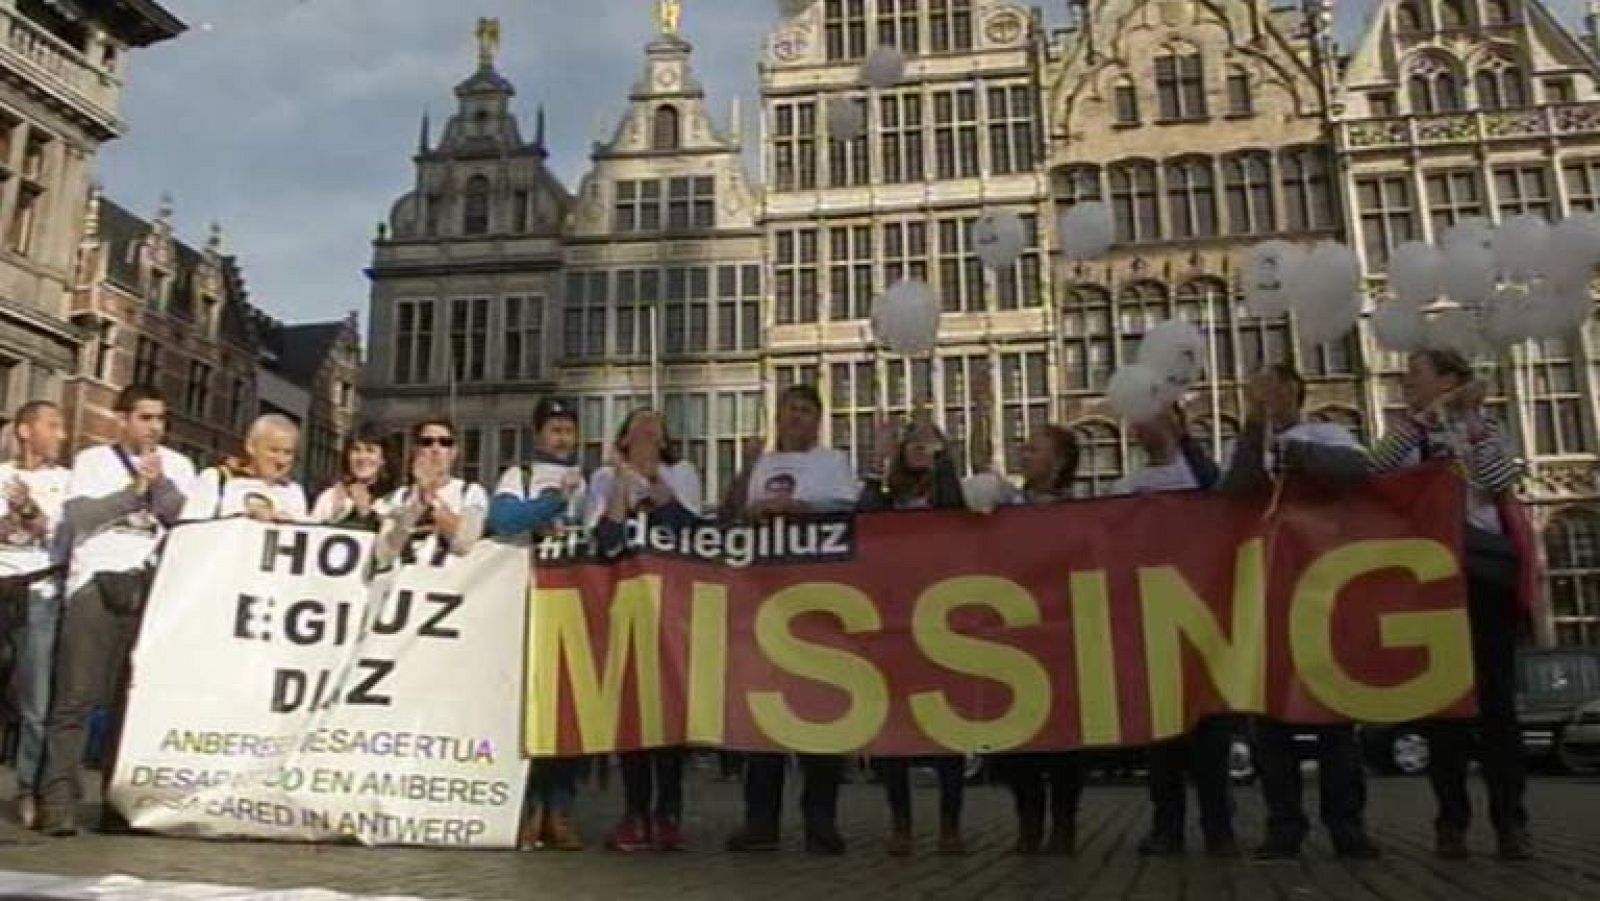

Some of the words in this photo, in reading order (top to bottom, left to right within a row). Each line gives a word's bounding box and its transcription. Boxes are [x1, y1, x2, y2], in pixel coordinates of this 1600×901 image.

[527, 537, 1475, 755] MISSING
[311, 768, 353, 793] EN
[358, 771, 510, 806] AMBERES
[301, 807, 330, 832] IN
[338, 811, 486, 844] ANTWERP
